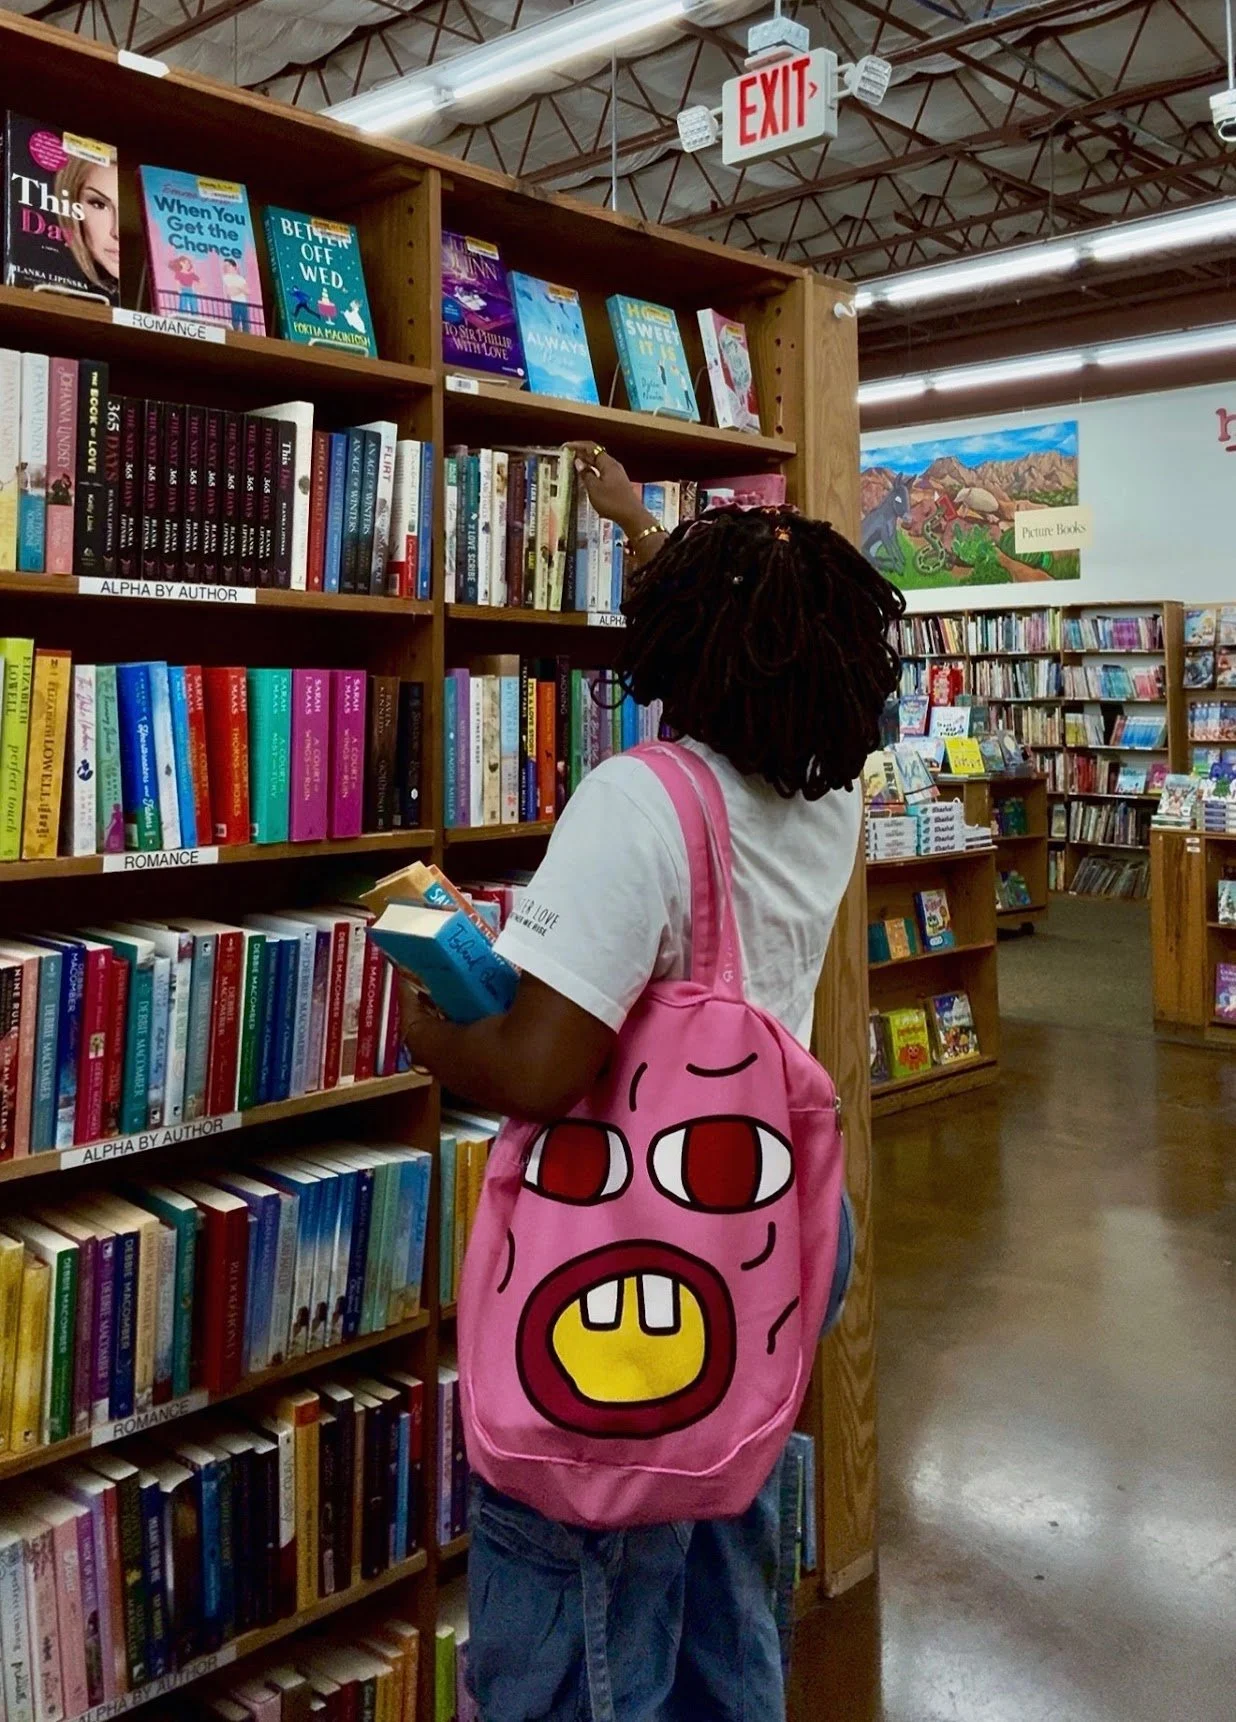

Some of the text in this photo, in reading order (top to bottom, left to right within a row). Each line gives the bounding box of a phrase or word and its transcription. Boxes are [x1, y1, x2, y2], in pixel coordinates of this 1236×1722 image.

[738, 57, 811, 146] EXIT
[11, 172, 86, 221] This
[153, 194, 246, 226] When You
[167, 216, 239, 242] Get the
[168, 234, 243, 260] Chance
[301, 243, 334, 266] OFF
[131, 312, 207, 341] ROMANCE
[443, 321, 458, 337] TO
[453, 335, 509, 361] WITH LOVE
[527, 331, 588, 357] ALWAYS
[55, 366, 75, 471] JOHANNA LINDSEY
[89, 387, 100, 425] BOOK
[106, 400, 121, 433] 365
[87, 440, 99, 475] LOVE
[281, 441, 292, 466] This
[353, 437, 361, 452] AN
[368, 440, 377, 453] AN
[125, 461, 134, 480] 365
[147, 463, 157, 482] 365
[169, 468, 178, 485] 365
[189, 468, 198, 485] 365
[207, 470, 217, 488] 365
[351, 452, 360, 476] AGE
[366, 453, 376, 477] AGE
[382, 445, 394, 483] FLIRT
[226, 472, 236, 490] 365
[246, 474, 255, 492] 365
[263, 476, 272, 494] 365
[348, 490, 359, 533] WINTERS
[363, 491, 375, 535] WINTERS
[467, 529, 477, 553] LOVE
[1022, 520, 1087, 539] Picture Books
[101, 581, 238, 602] ALPHA BY AUTHOR
[6, 664, 19, 716] LOWELL
[19, 656, 32, 726] ELIZABETH
[194, 675, 203, 711] SARAH
[230, 684, 238, 715] MAAS
[280, 676, 288, 713] SARAH
[304, 684, 313, 716] MAAS
[313, 678, 322, 713] SARAH
[344, 683, 352, 715] MAAS
[352, 677, 360, 713] SARAH
[40, 738, 56, 799] LOWELL
[232, 727, 241, 817] THORNS ROSES
[279, 747, 287, 783] COURT
[313, 748, 321, 783] COURT
[350, 747, 358, 782] COURT
[6, 744, 20, 834] perfect touch
[124, 850, 200, 869] ROMANCE
[531, 921, 548, 937] RISE
[533, 904, 560, 930] LOVE
[251, 942, 261, 974] DEBBIE
[67, 952, 79, 1013] MACOMBER
[365, 965, 378, 1029] MACOMBER
[10, 968, 21, 1041] NINE RULES
[217, 975, 229, 1037] MACOMBER
[133, 1000, 150, 1099] DEBBIE MACOMBER
[83, 1118, 224, 1163] ALPHA BY AUTHOR
[120, 1238, 135, 1351] DEBBIE MACOMBER
[113, 1400, 190, 1438] ROMANCE
[132, 1689, 151, 1705] BY
